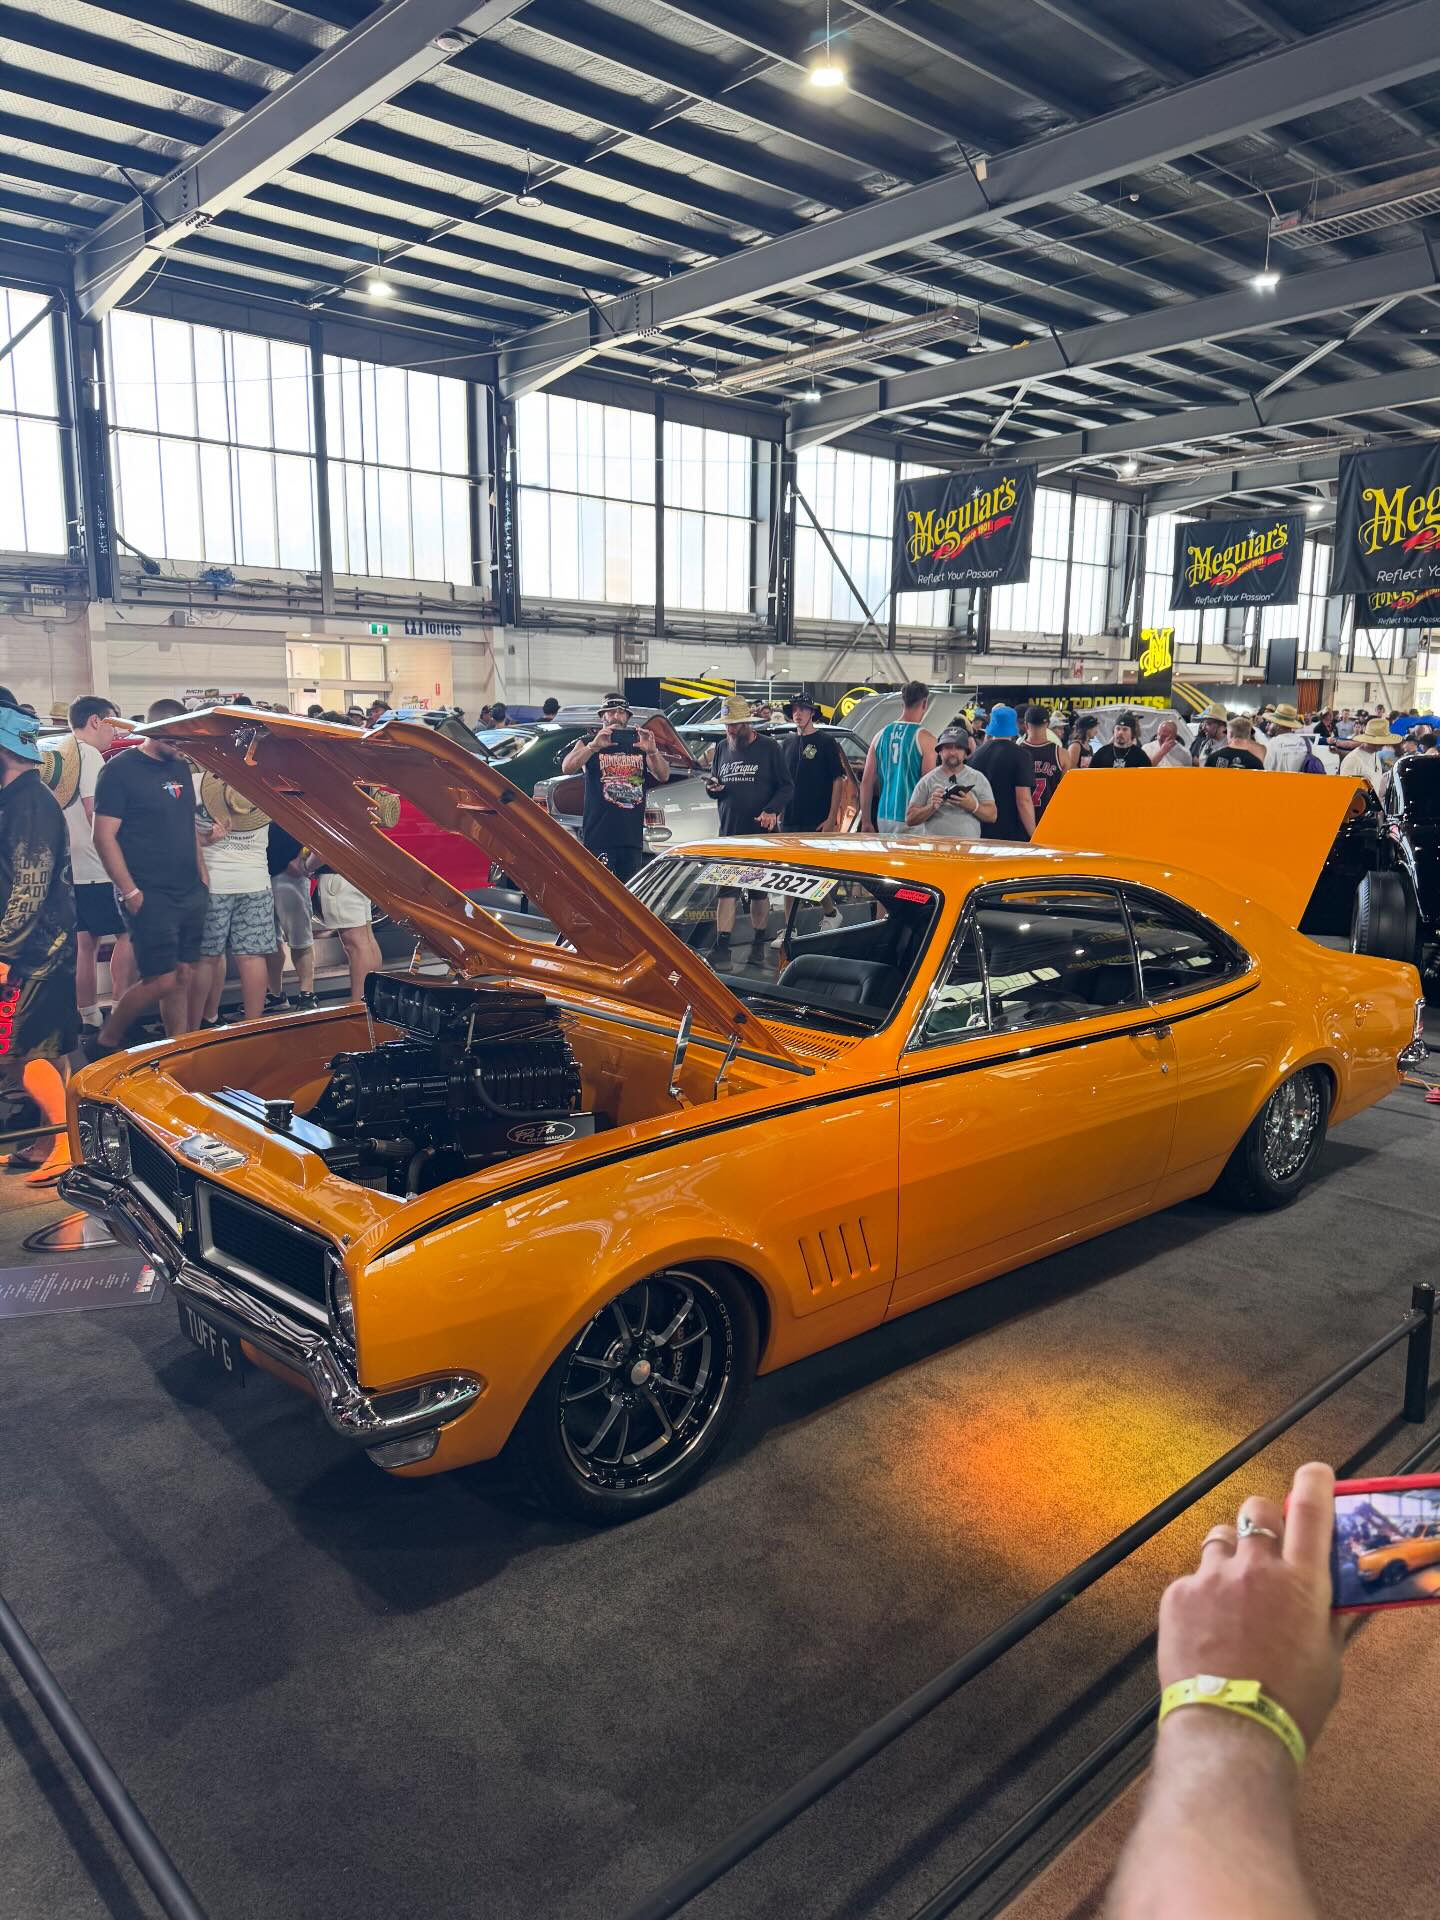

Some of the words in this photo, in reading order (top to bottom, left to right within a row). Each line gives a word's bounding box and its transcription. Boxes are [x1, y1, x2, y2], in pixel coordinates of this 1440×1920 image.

[906, 476, 1016, 563] Meguiar's
[1184, 523, 1288, 588] Meguiar's
[917, 573, 945, 585] Reflect
[947, 570, 965, 581] Your
[1377, 567, 1424, 585] Reflect
[1195, 595, 1221, 605] Reflect
[1223, 593, 1240, 602] Your
[760, 872, 820, 895] 2827
[185, 1306, 217, 1357] TUFF
[221, 1337, 233, 1371] G
